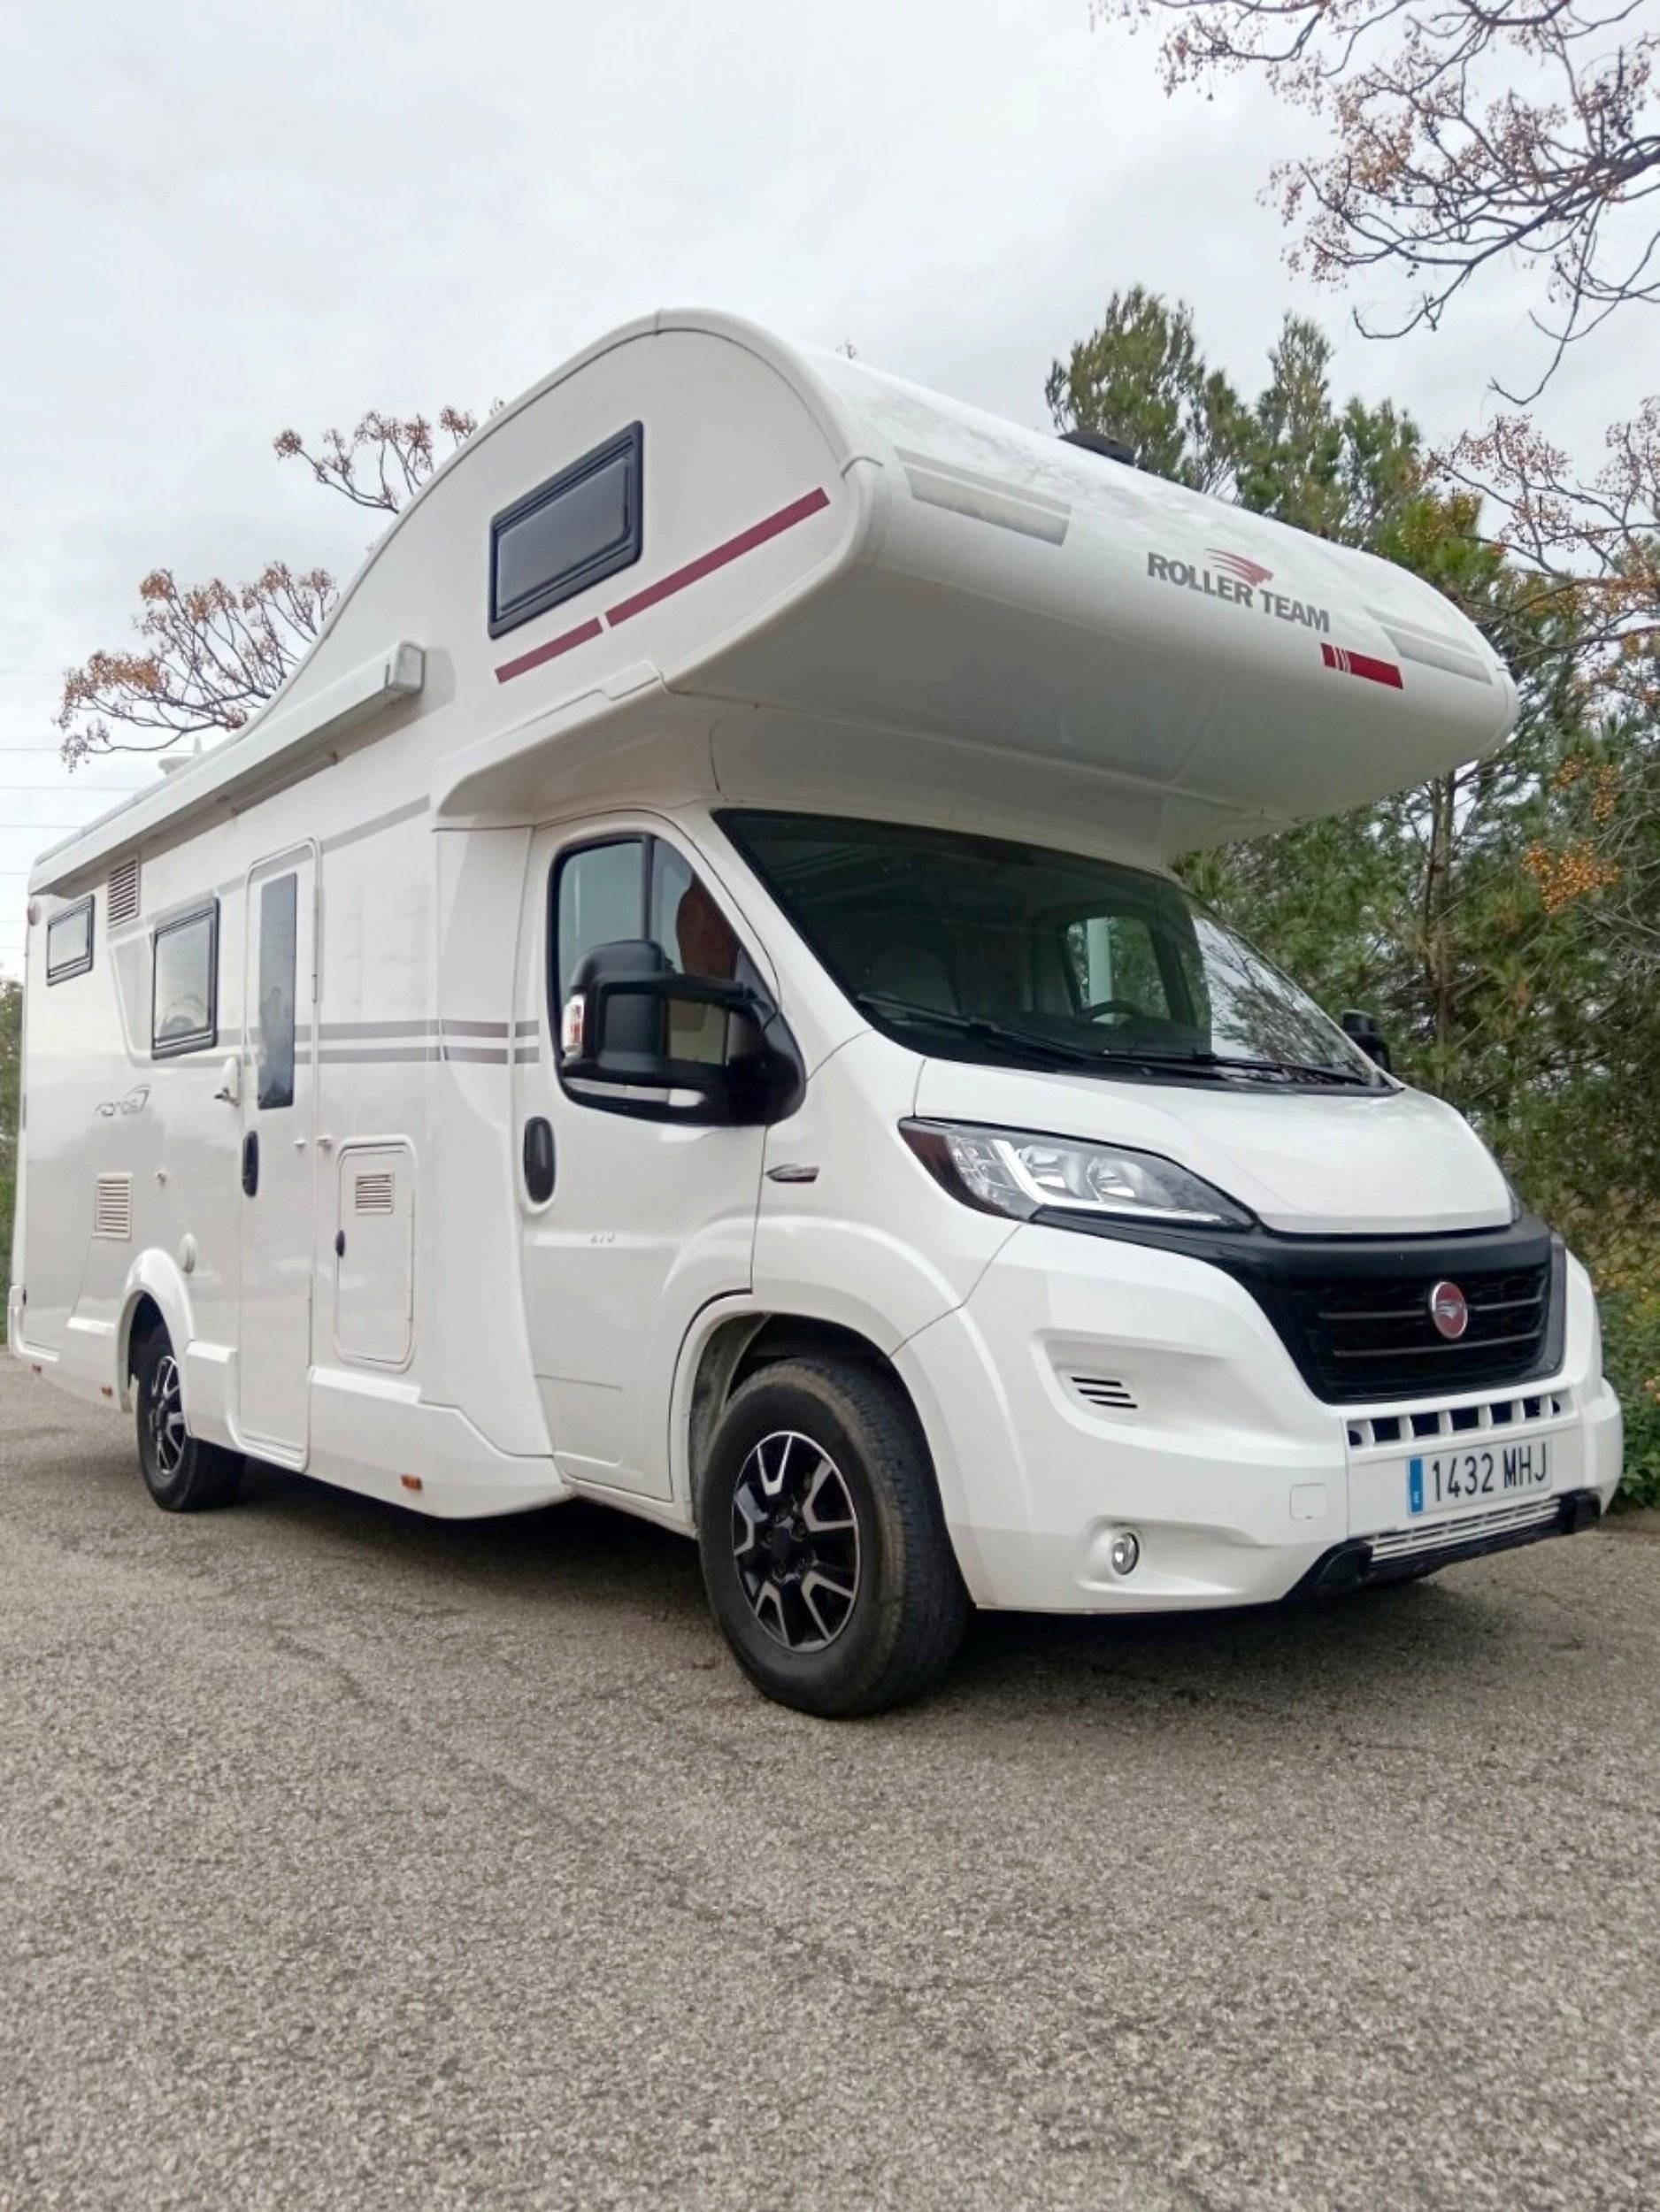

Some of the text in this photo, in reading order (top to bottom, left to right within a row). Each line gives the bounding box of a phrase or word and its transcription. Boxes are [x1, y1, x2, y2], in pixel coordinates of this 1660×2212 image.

[1147, 551, 1330, 633] ROLLER TEAM
[1432, 1441, 1547, 1502] 1432 MHJ
